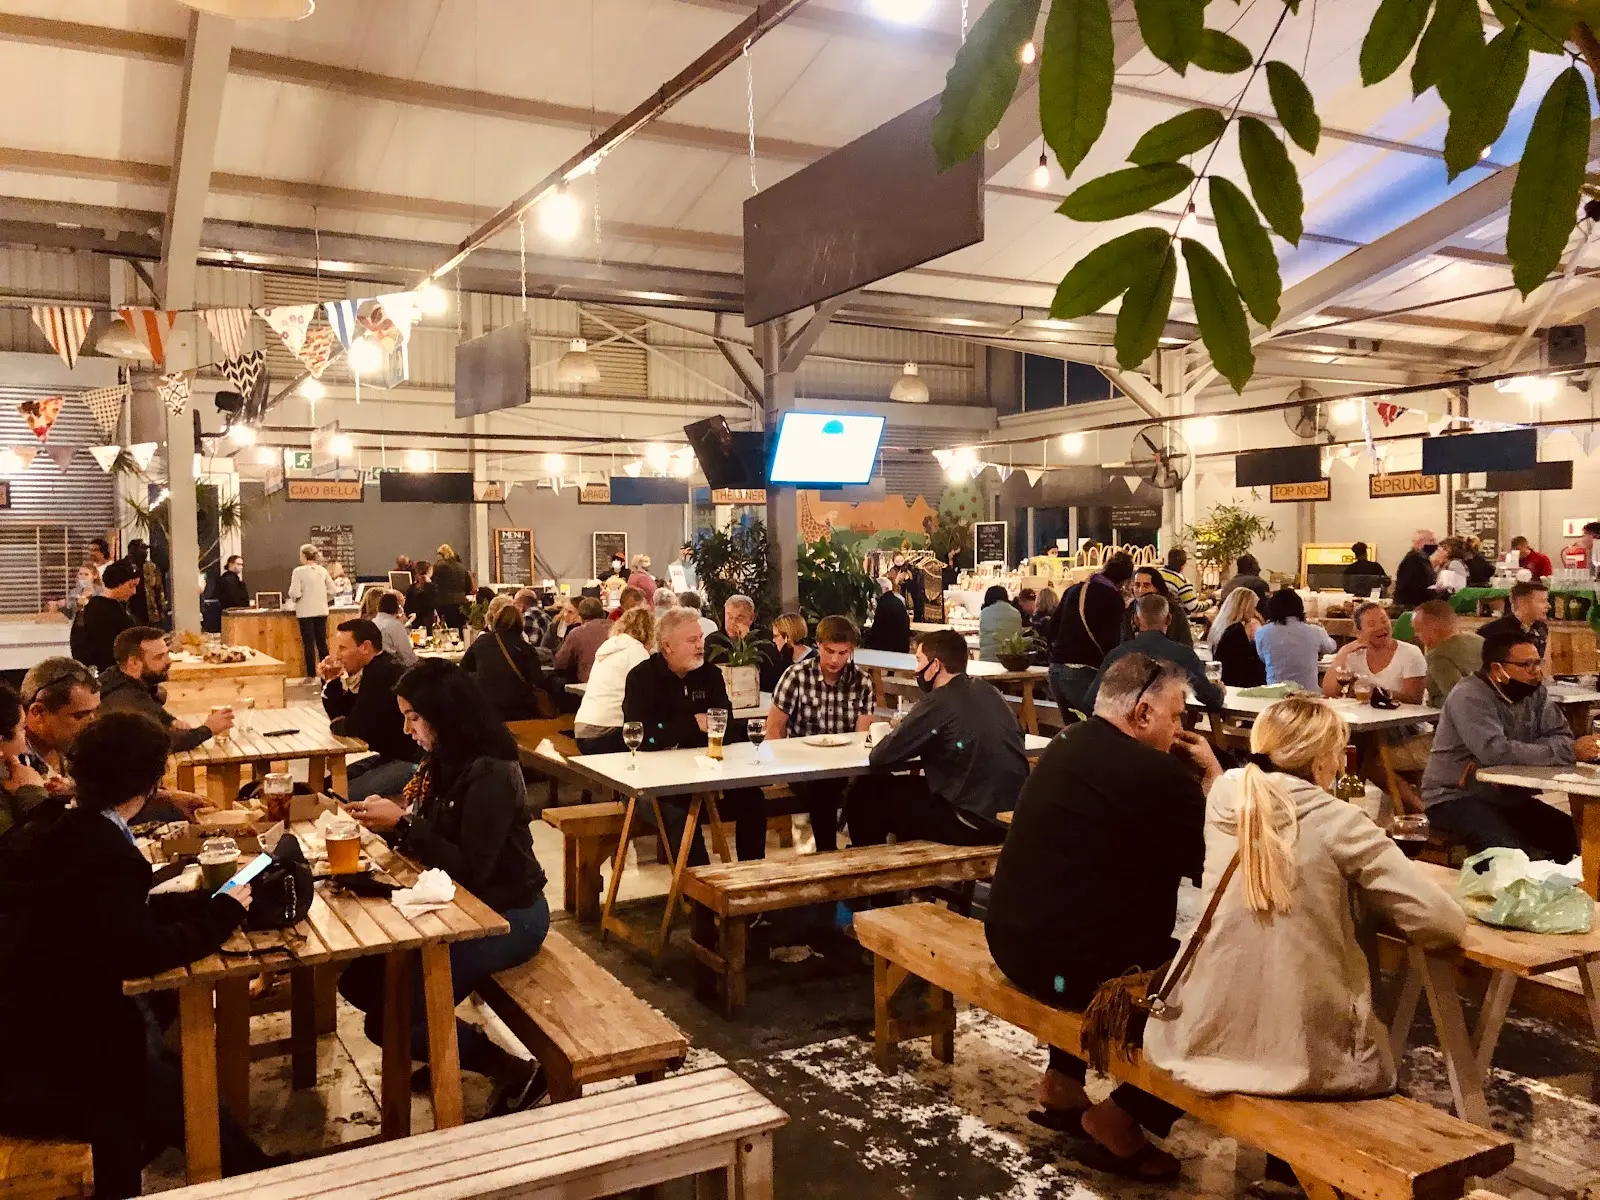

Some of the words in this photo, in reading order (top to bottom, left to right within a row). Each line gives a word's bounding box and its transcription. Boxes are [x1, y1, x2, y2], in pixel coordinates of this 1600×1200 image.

[1373, 476, 1435, 493] SPRUNG
[290, 485, 320, 495] CIAO
[322, 486, 359, 496] BELLA
[714, 490, 733, 501] THE
[735, 490, 765, 501] DNER
[1274, 486, 1295, 497] TOP
[1296, 484, 1327, 496] NOSH
[502, 531, 525, 539] MENU
